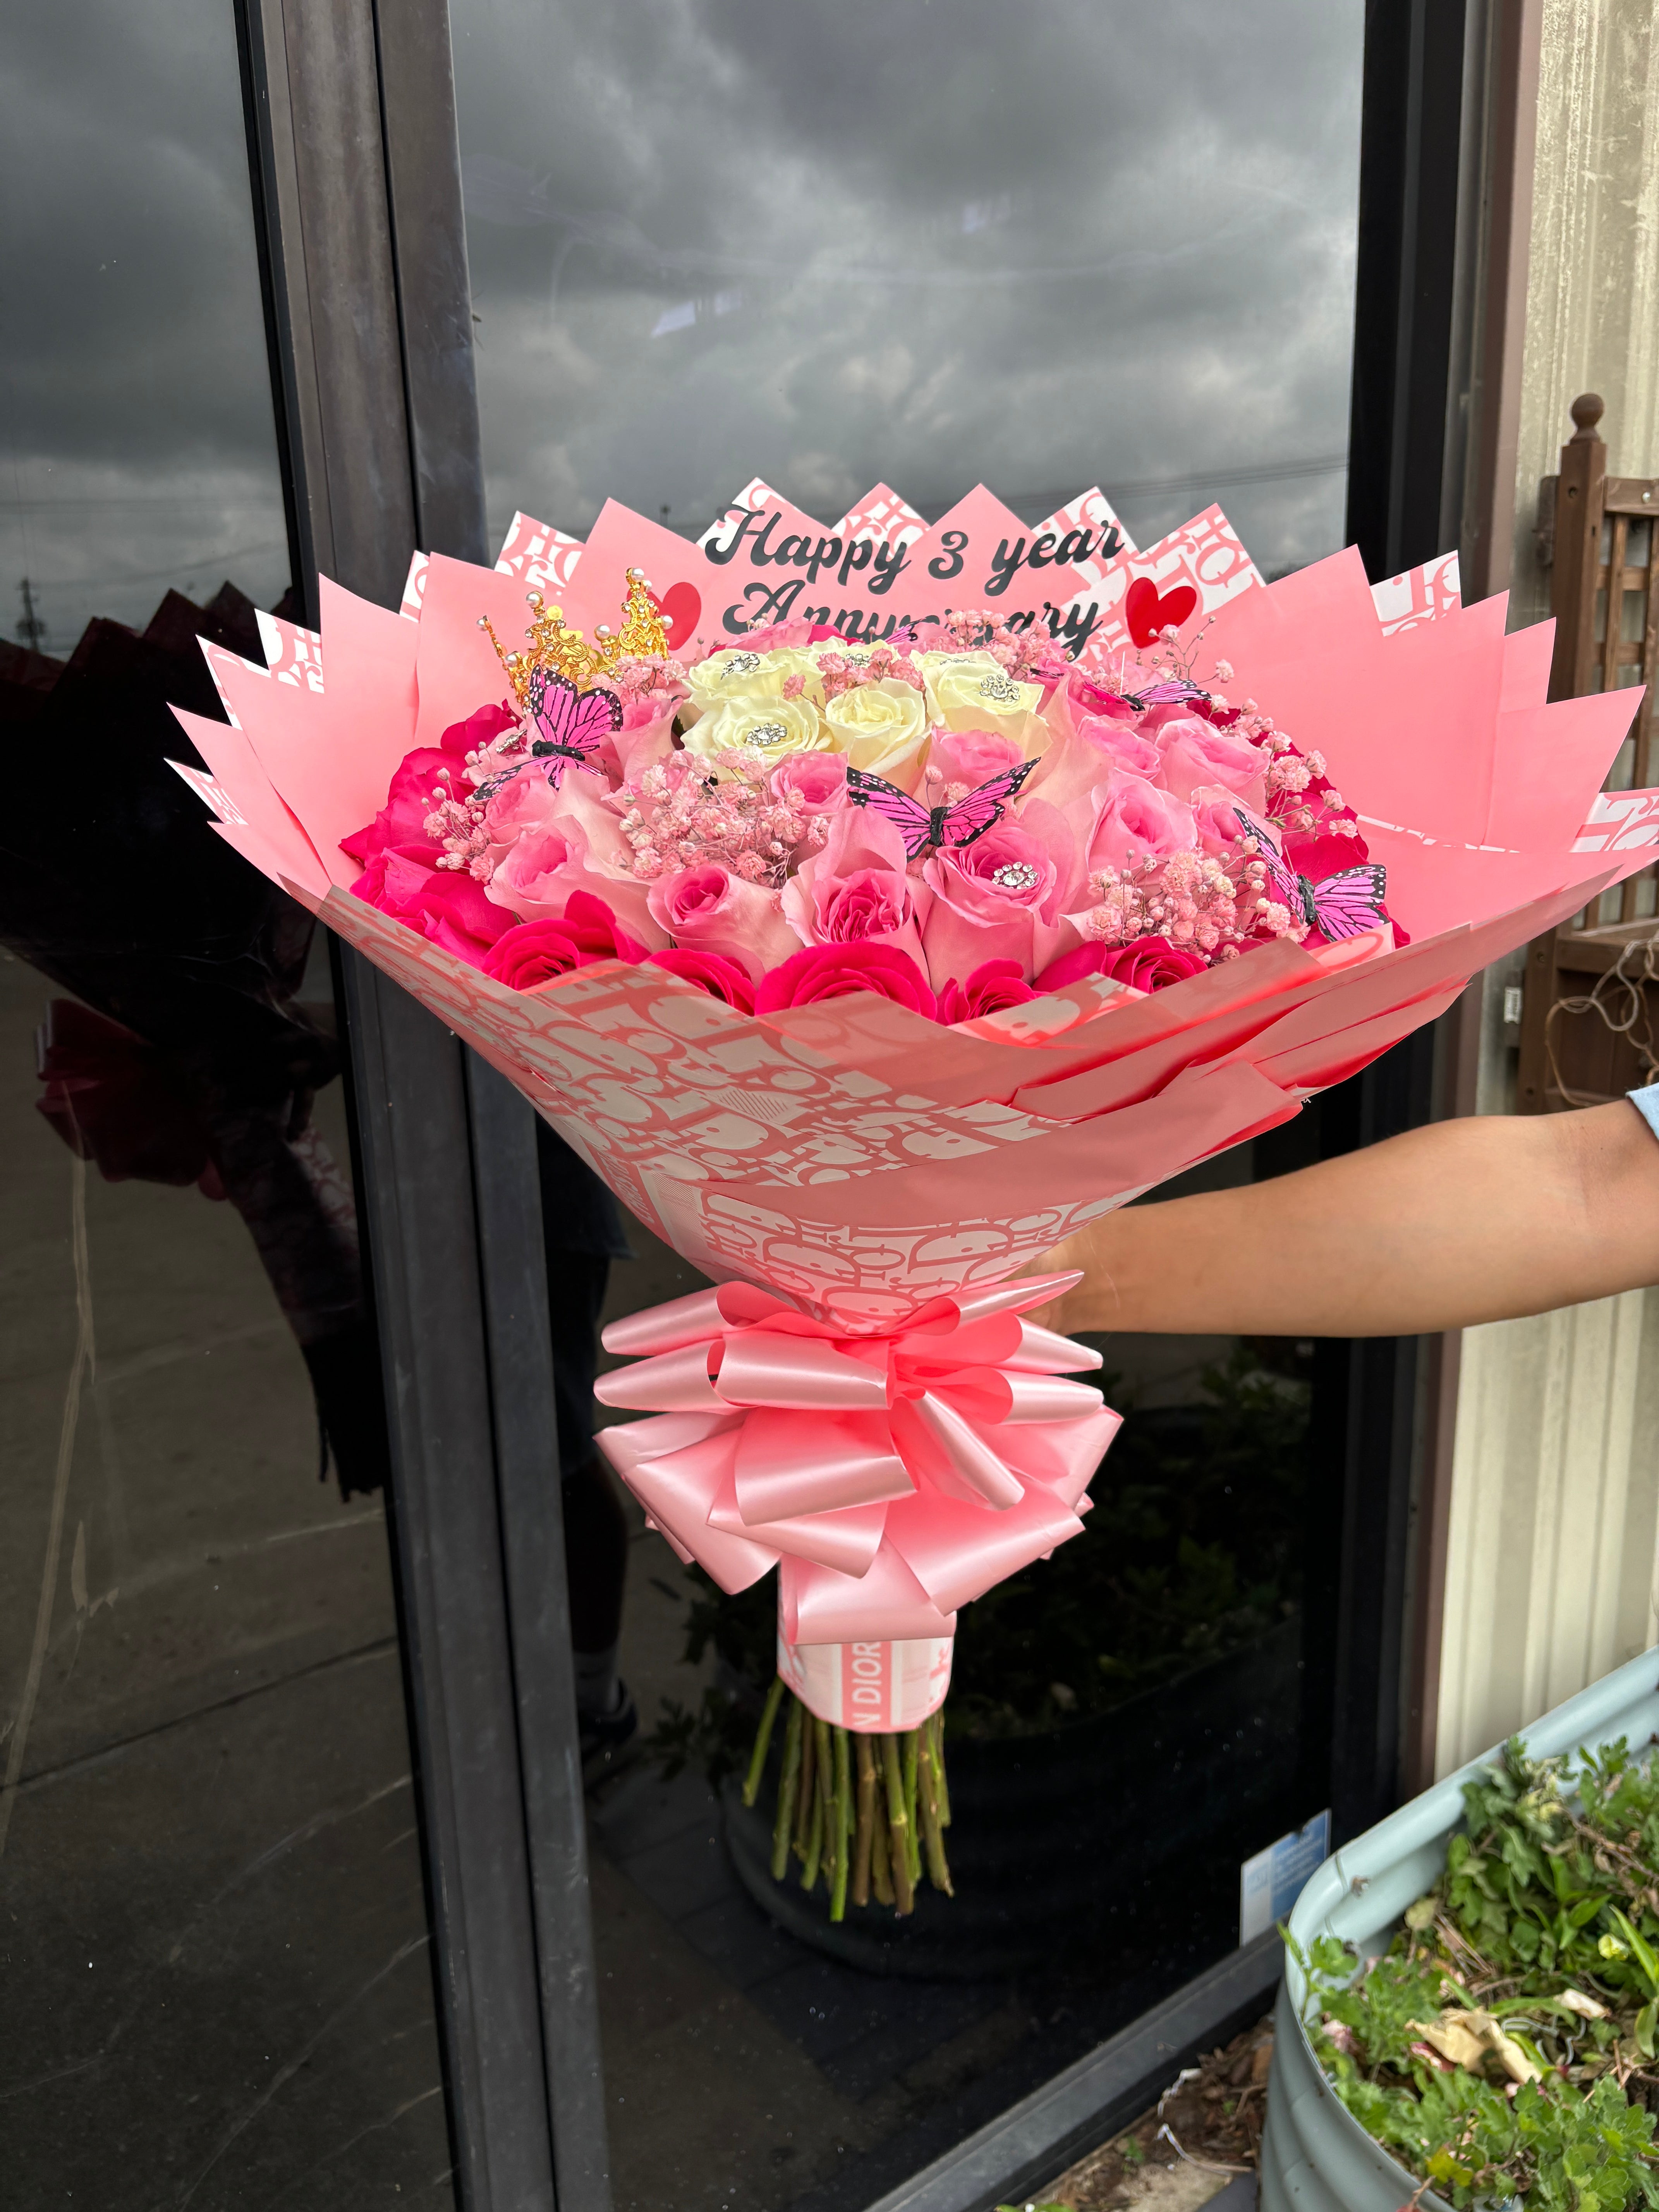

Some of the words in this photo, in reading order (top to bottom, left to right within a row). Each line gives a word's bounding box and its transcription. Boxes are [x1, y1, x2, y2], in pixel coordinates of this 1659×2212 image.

[705, 504, 912, 595] Happy
[927, 531, 970, 580] 3
[984, 519, 1126, 597] year
[722, 579, 1104, 663] Annivary
[852, 1642, 882, 1705] DIOR
